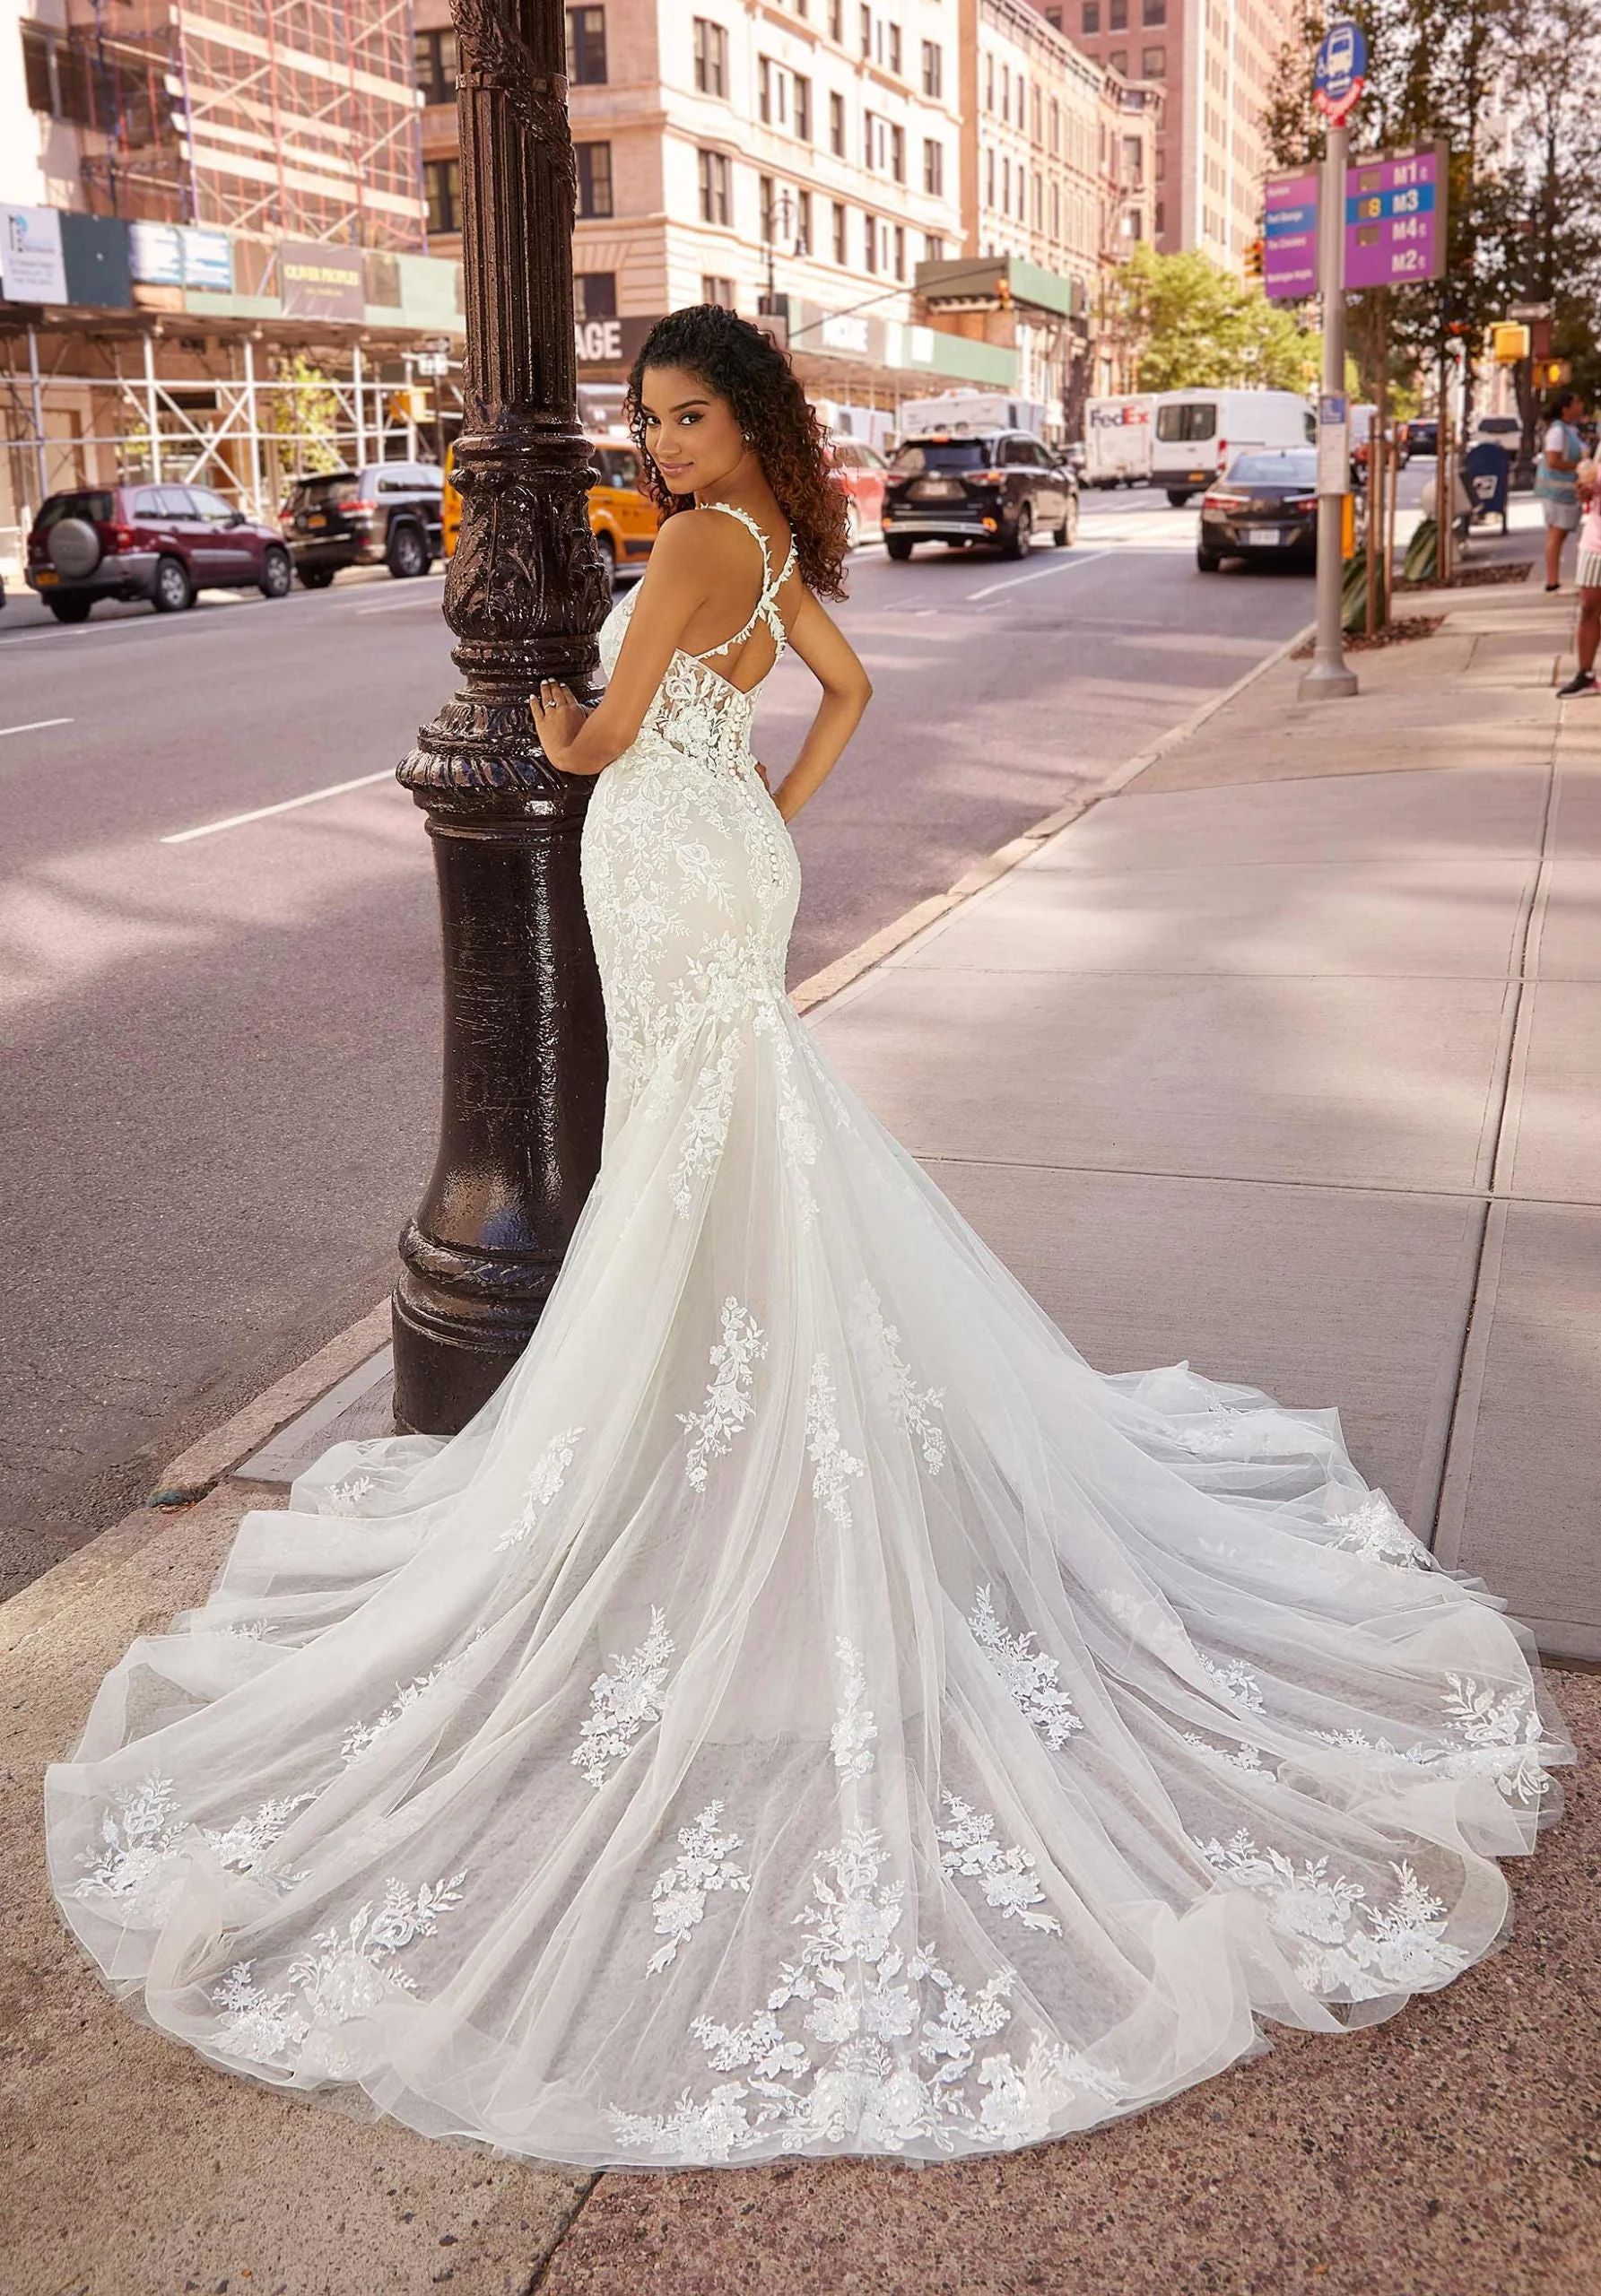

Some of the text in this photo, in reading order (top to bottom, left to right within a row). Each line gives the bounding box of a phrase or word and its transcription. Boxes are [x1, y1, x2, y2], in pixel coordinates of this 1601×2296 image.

[1393, 161, 1417, 187] M1
[1368, 196, 1381, 218] 8
[1392, 188, 1419, 214] M3
[1392, 217, 1417, 241] M4
[1391, 249, 1417, 273] M2
[1091, 406, 1150, 428] FedEx
